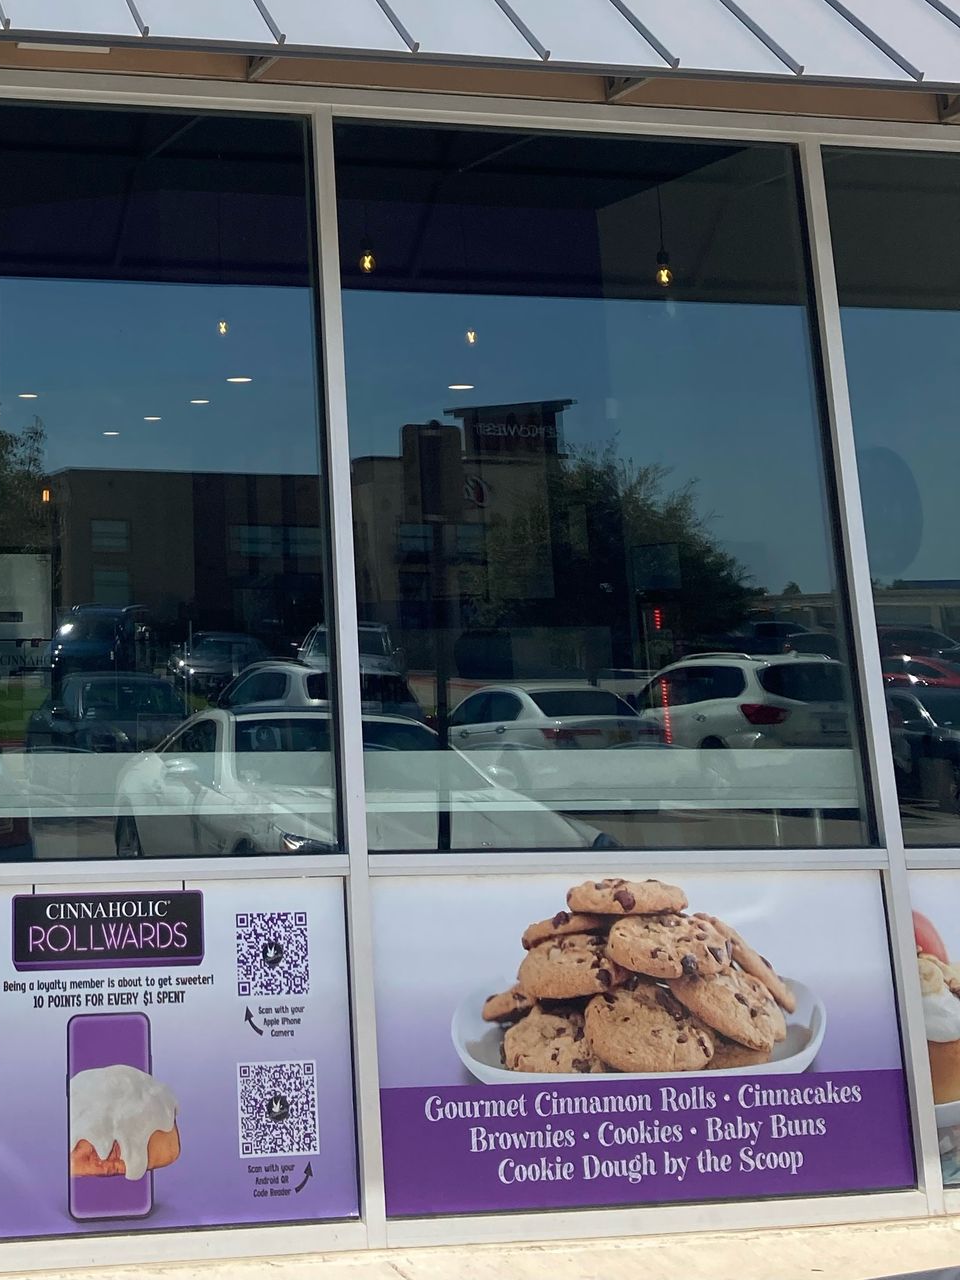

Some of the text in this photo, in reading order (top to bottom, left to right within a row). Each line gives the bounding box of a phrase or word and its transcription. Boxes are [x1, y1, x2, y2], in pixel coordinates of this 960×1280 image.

[28, 921, 188, 953] ROLLWARDS
[3, 980, 26, 993] Being
[28, 982, 35, 991] a
[37, 979, 68, 993] loyalty
[69, 978, 105, 990] member
[117, 976, 142, 988] about
[145, 976, 156, 987] to
[157, 976, 173, 989] get
[175, 974, 214, 986] sweeter!
[33, 990, 186, 1008] 10 POINTS FOR EVERY $1 SPENT
[258, 1005, 305, 1015] Scan with your
[263, 1017, 280, 1026] Apple
[270, 1029, 295, 1037] Camera
[424, 1080, 862, 1122] Gourmet Cinnamon Rolls Cinnacakes
[469, 1114, 827, 1153] Brownies Cookies Baby Buns
[247, 1164, 295, 1173] Scan with your
[497, 1146, 804, 1185] Cookie Dough by the Scoop
[255, 1175, 289, 1185] Android QR
[253, 1188, 291, 1197] Code Reader
